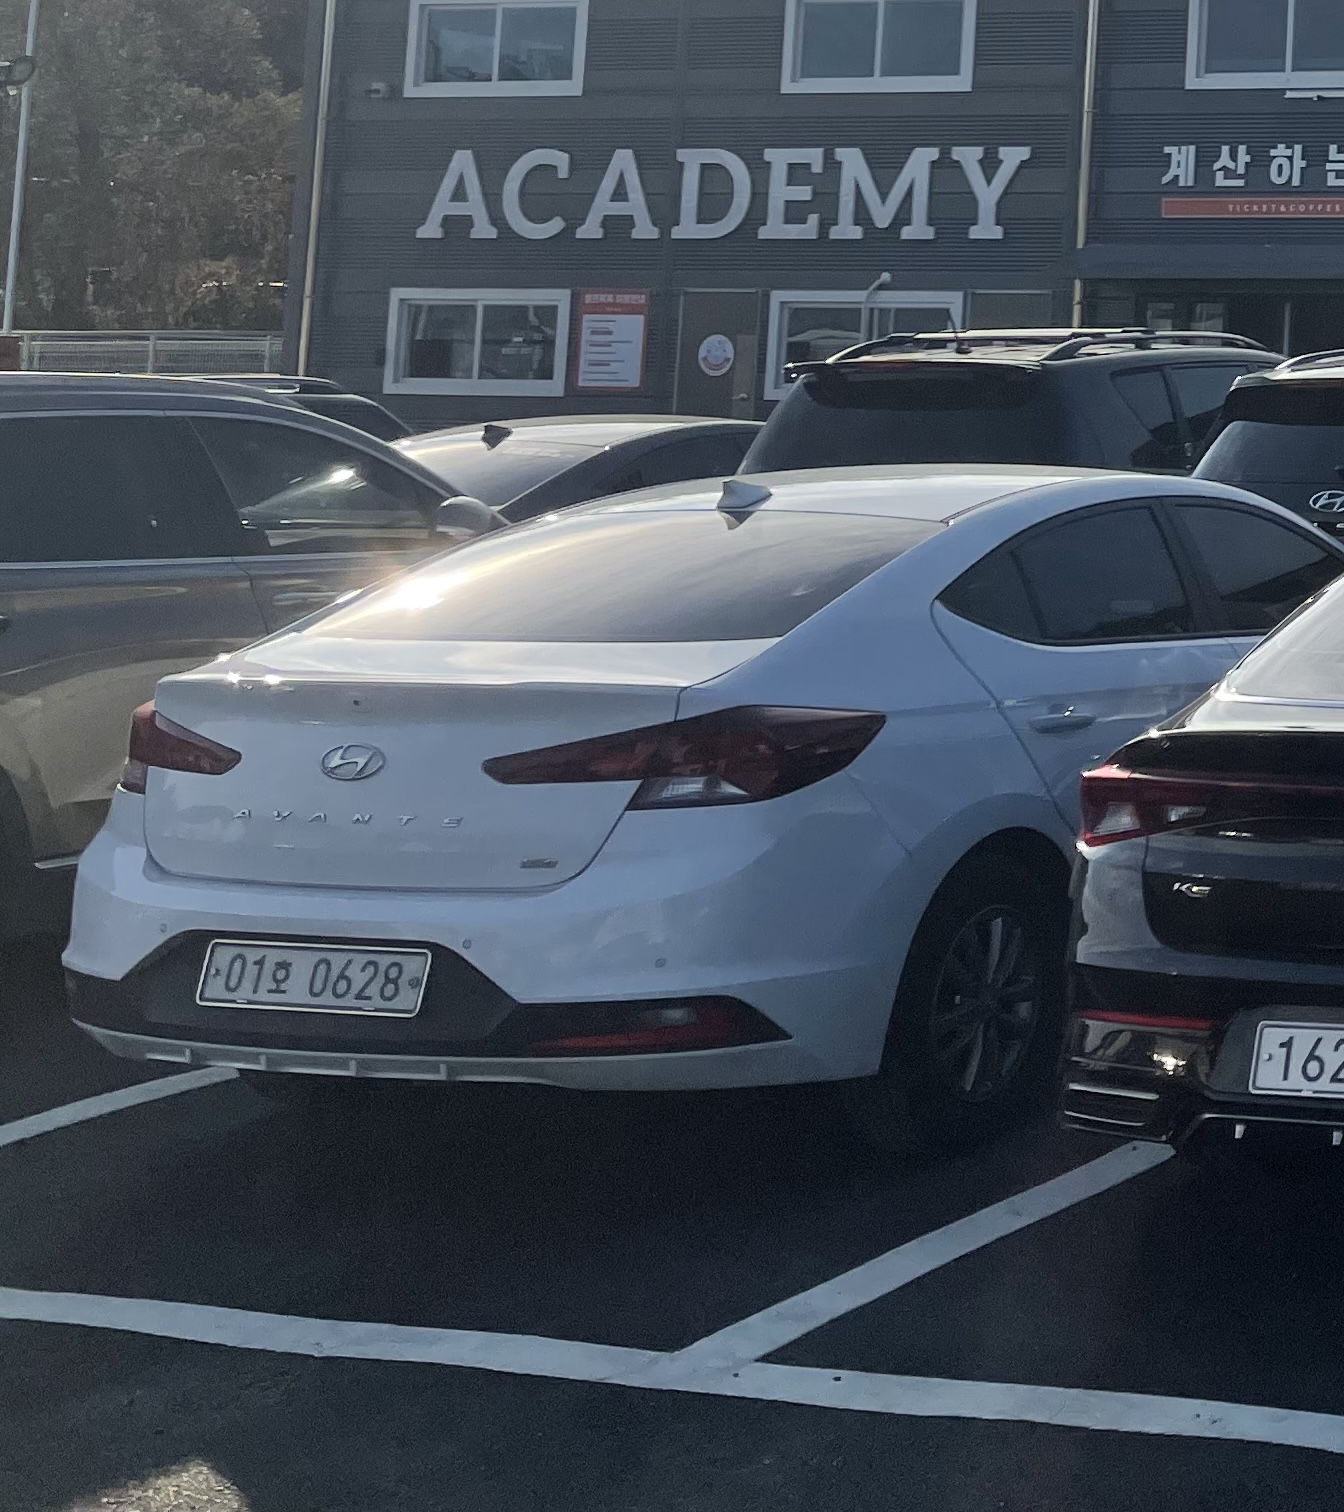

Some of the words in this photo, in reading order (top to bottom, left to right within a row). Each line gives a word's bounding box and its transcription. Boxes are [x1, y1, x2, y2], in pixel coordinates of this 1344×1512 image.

[415, 146, 1032, 240] ACADEMY
[232, 807, 464, 829] AVANTE
[308, 957, 404, 1002] 0628
